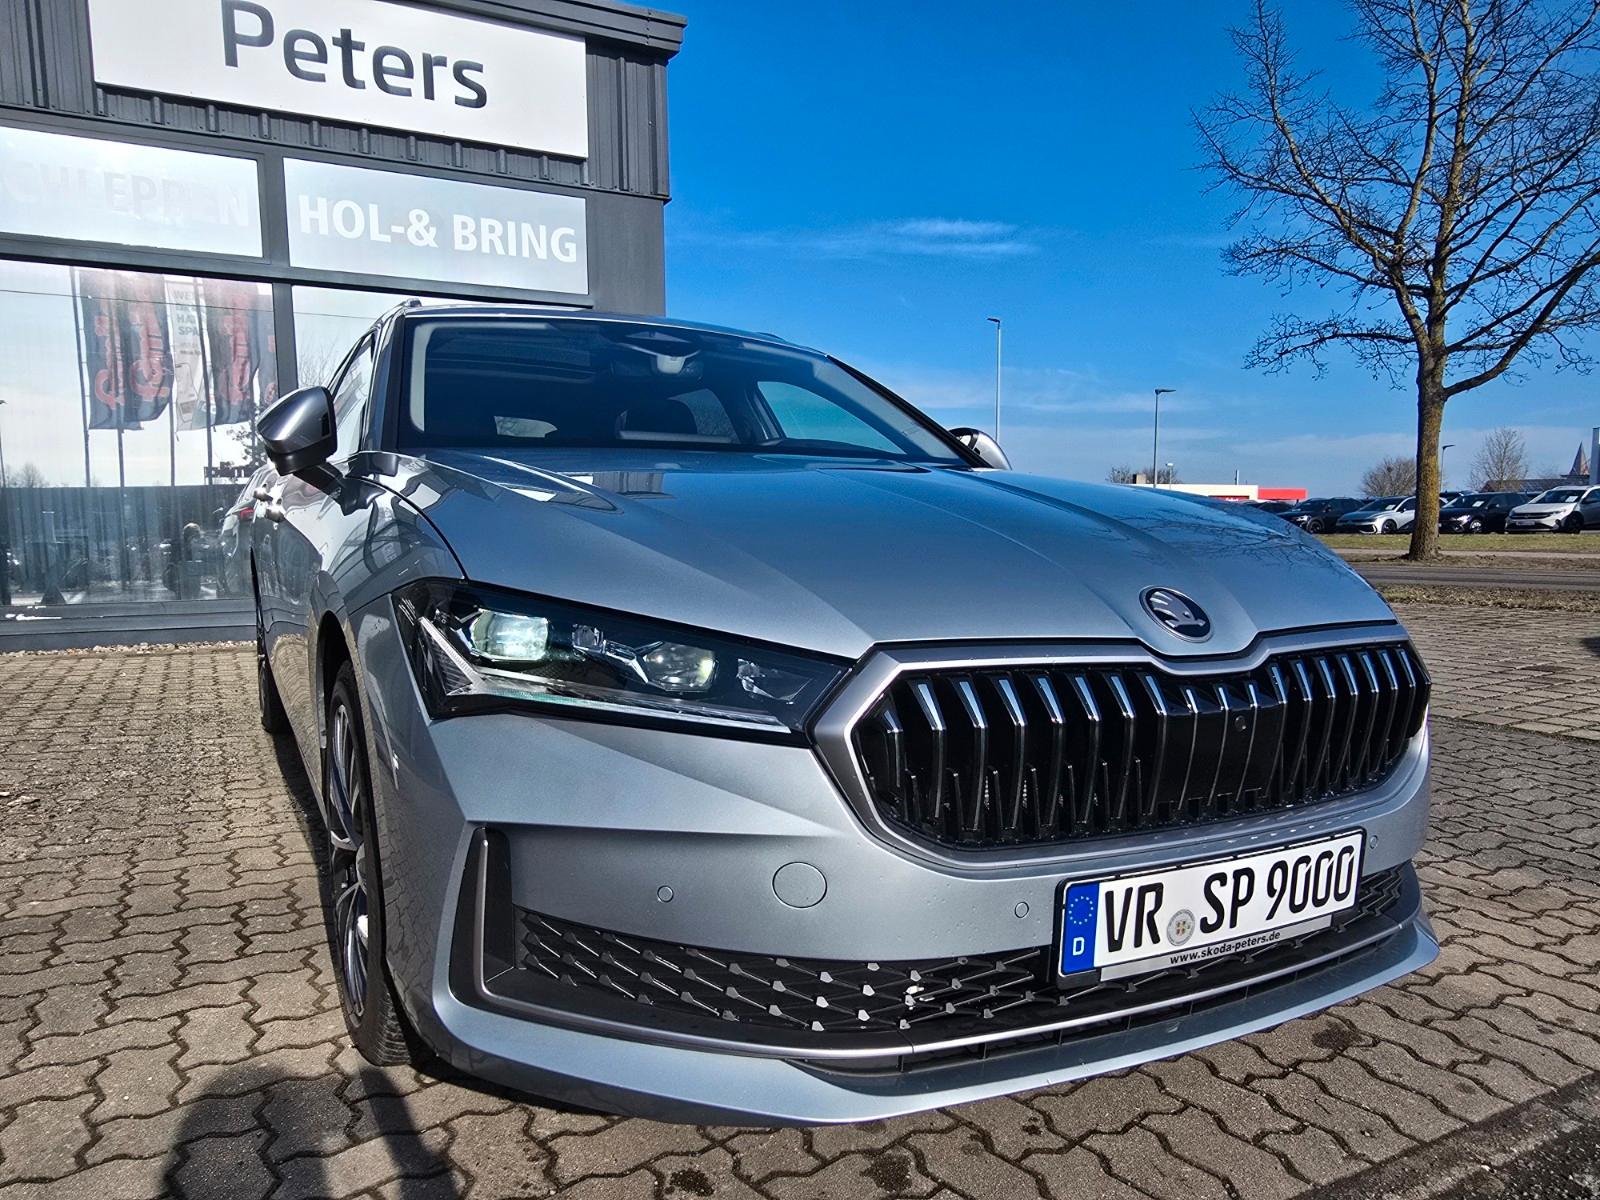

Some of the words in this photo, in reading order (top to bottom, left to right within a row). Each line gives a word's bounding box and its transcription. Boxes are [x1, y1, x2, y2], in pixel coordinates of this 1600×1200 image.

[221, 0, 488, 109] Peters
[453, 214, 578, 263] BRING
[1104, 882, 1164, 953] VR
[1200, 867, 1255, 934] SP
[1266, 845, 1355, 921] 9000
[1072, 936, 1085, 956] D
[1169, 930, 1281, 965] www.skoda-peters.de
